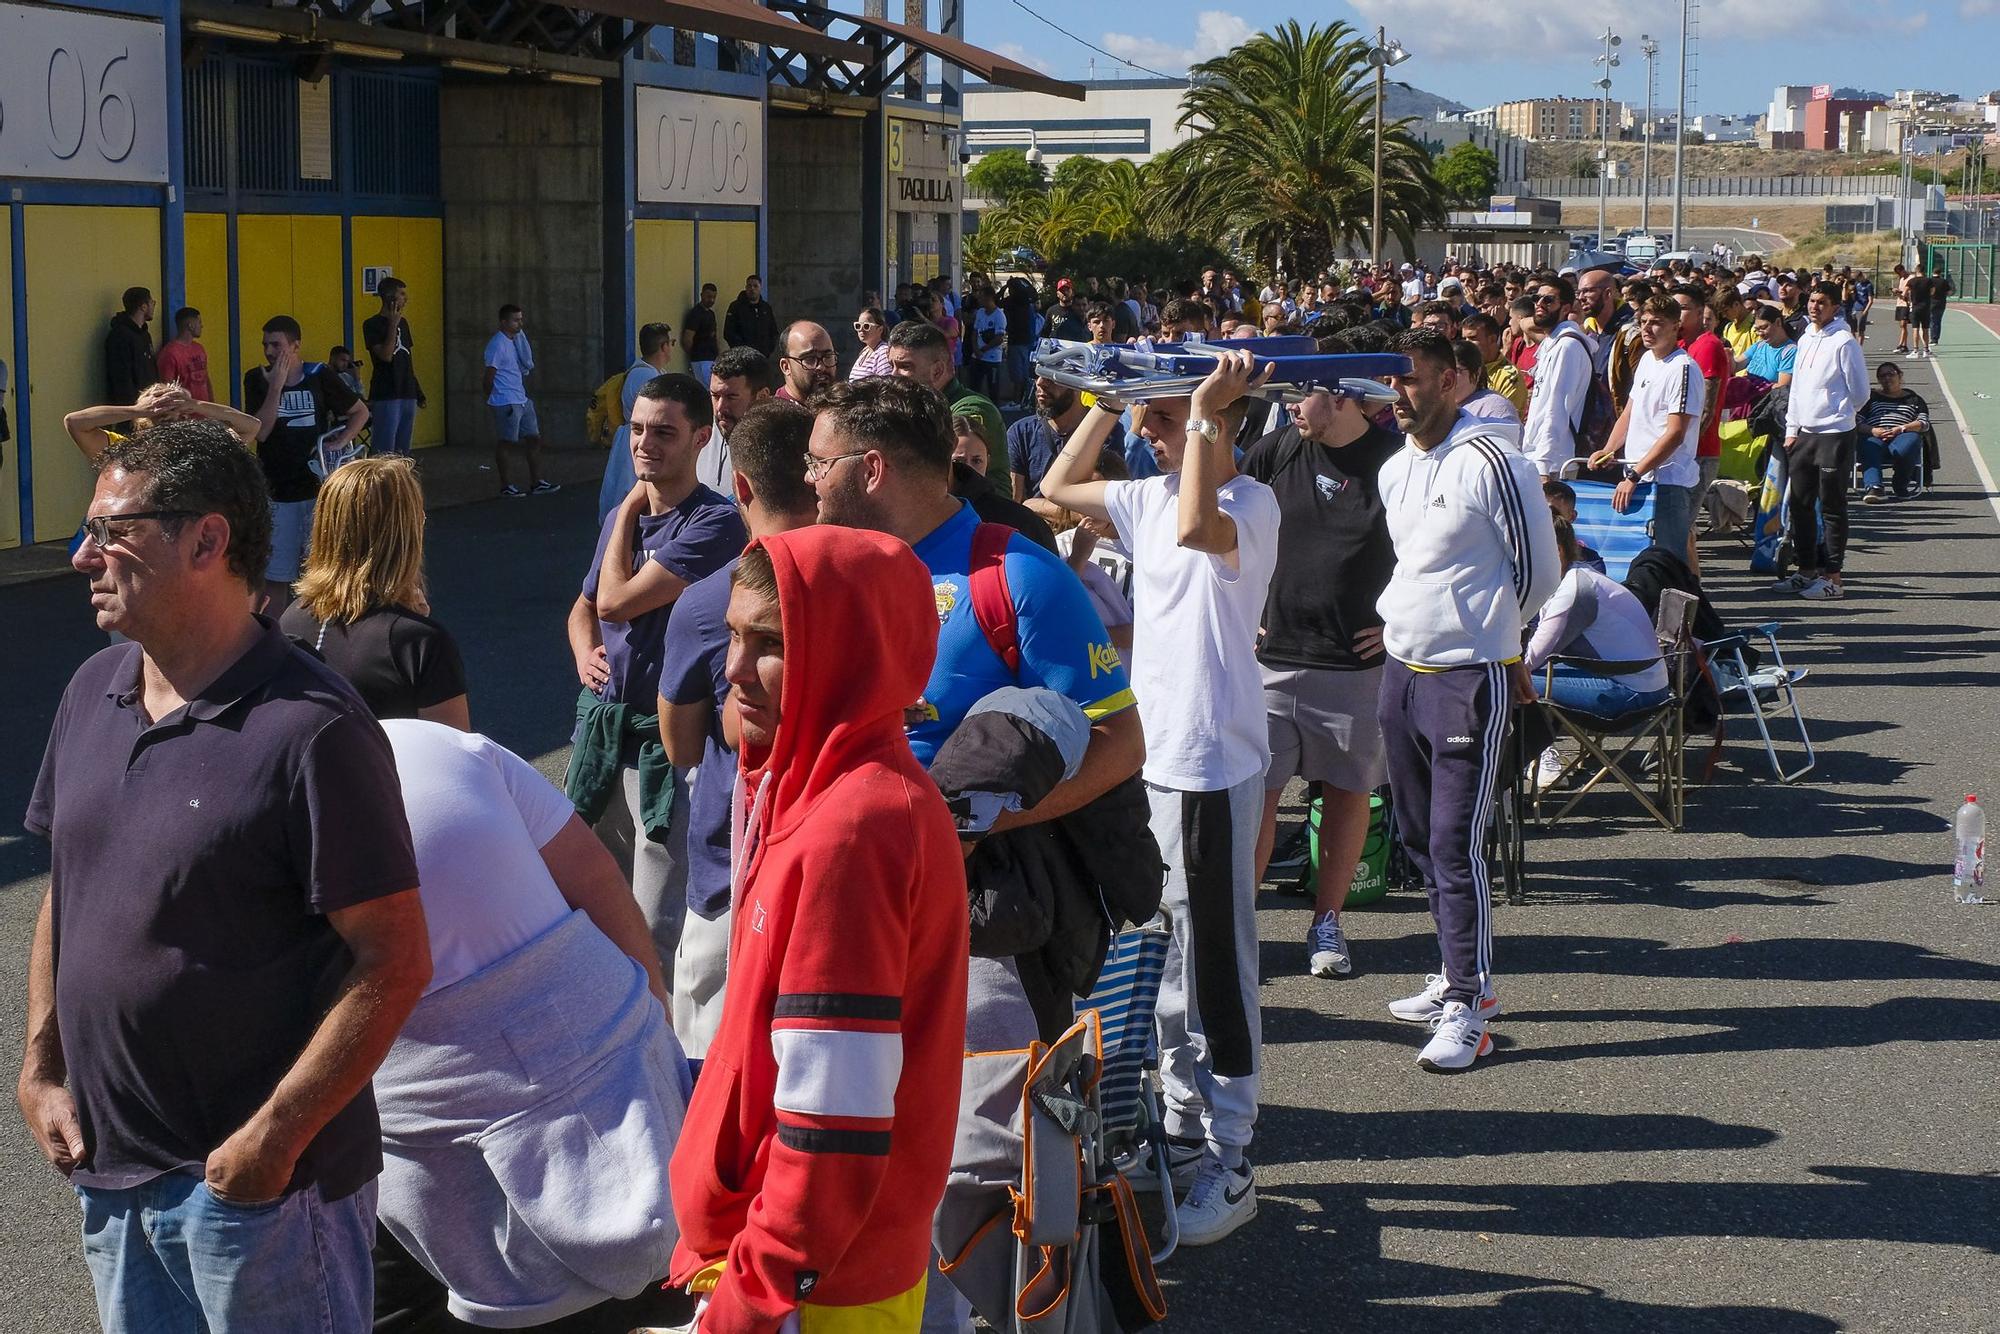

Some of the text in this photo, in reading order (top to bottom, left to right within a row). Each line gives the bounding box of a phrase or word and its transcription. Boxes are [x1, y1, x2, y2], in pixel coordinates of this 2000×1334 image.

[47, 45, 137, 163] 06
[657, 113, 749, 193] 07 08
[891, 125, 901, 167] 3
[897, 177, 954, 202] TAQUILLA
[1351, 874, 1381, 893] opical
